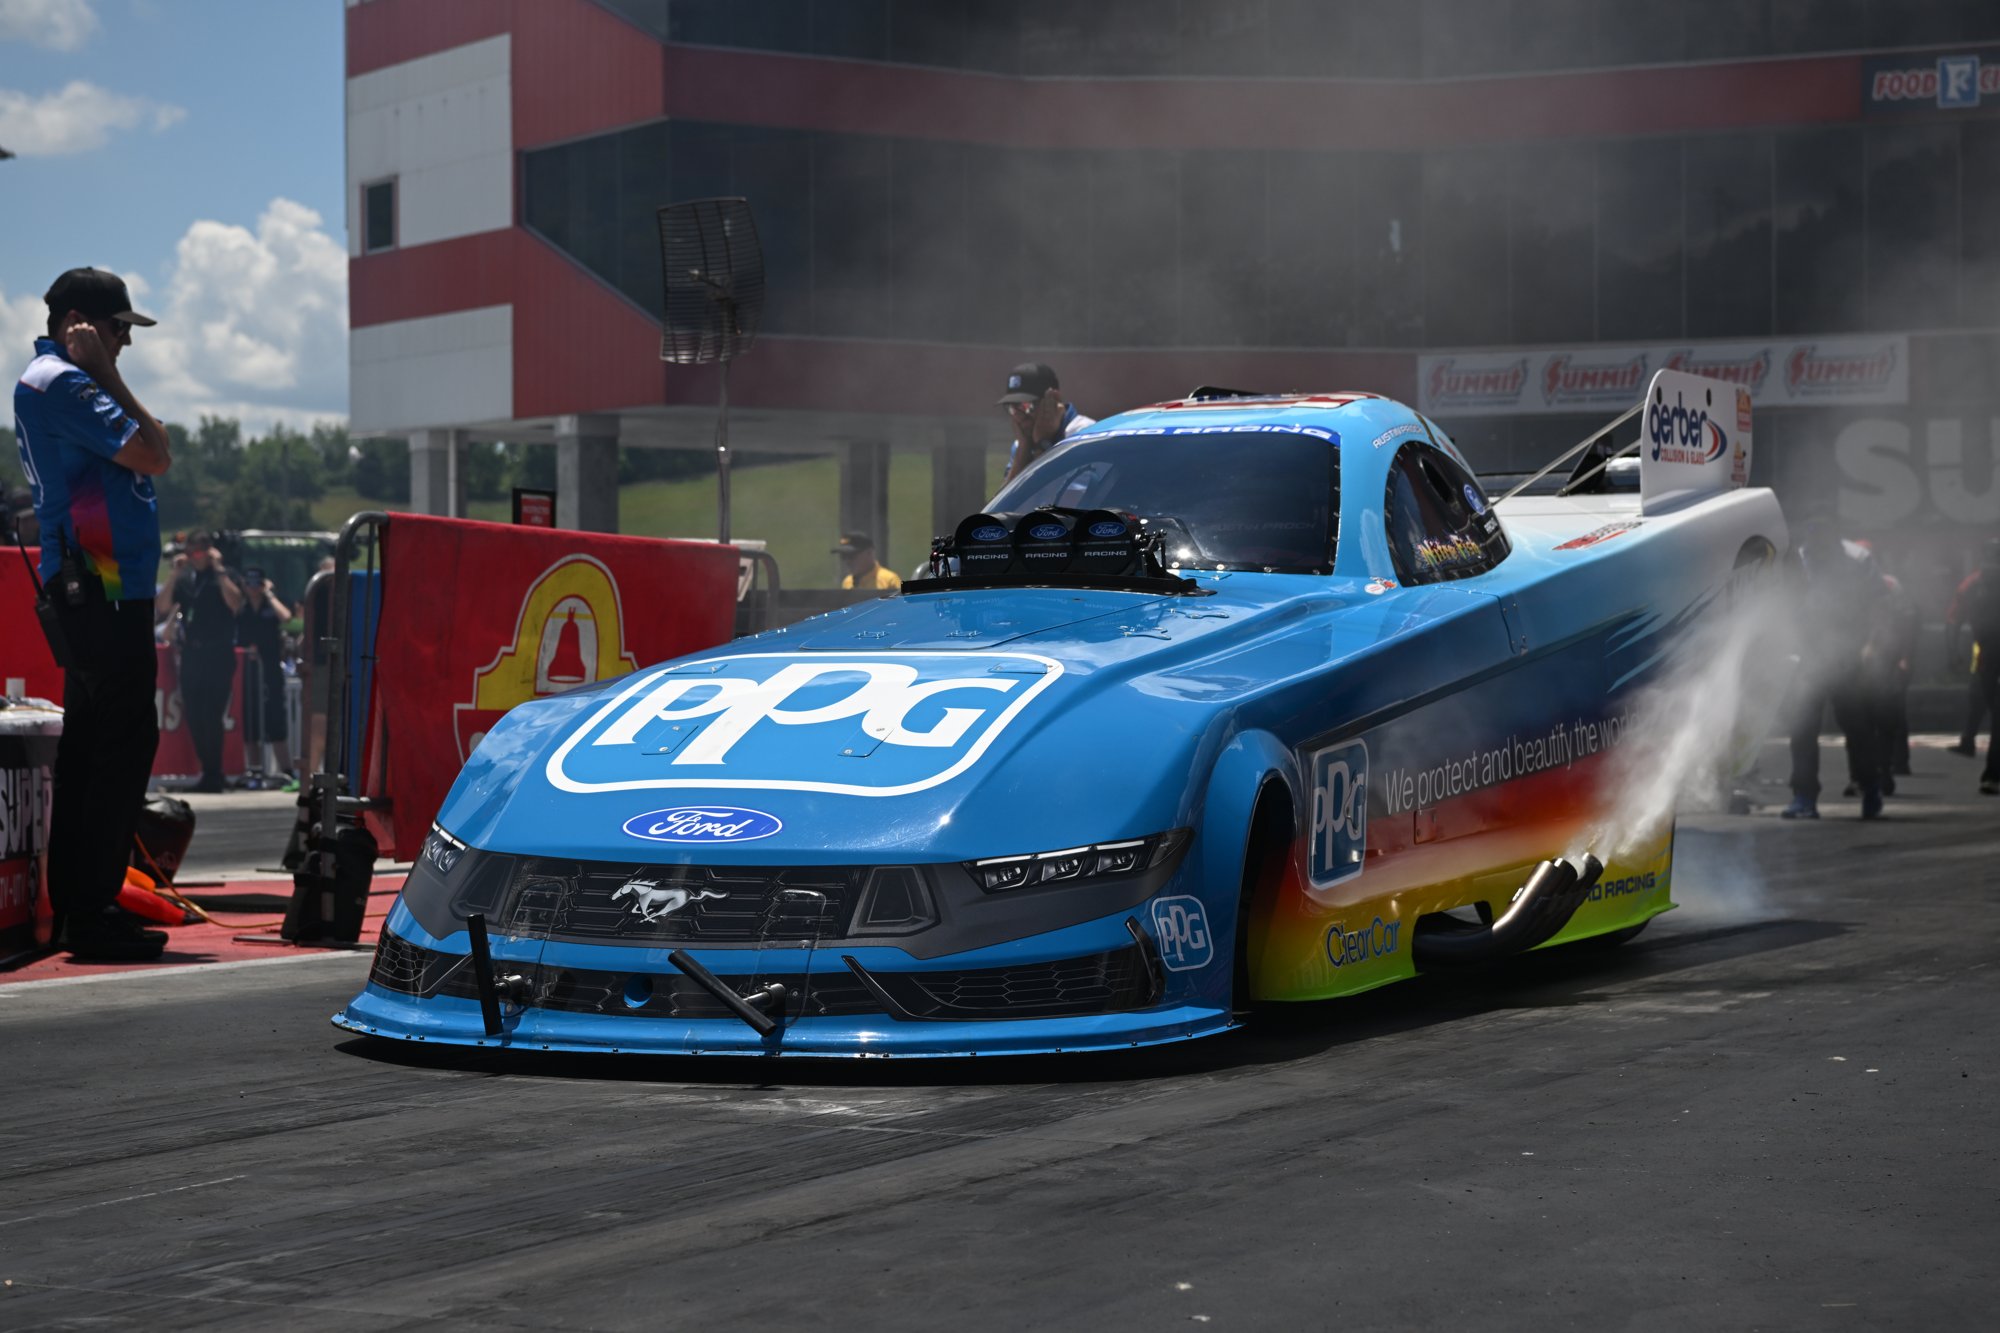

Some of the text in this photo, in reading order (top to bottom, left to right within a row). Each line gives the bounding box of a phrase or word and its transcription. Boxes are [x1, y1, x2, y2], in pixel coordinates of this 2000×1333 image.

[1873, 69, 1937, 101] FOOD
[1545, 358, 1641, 394] SUMMIT
[1173, 424, 1333, 440] RACING
[1650, 391, 1708, 462] gerber
[977, 528, 1002, 539] Ford
[1036, 526, 1061, 538] Ford
[1095, 524, 1120, 535] Ford
[1025, 551, 1068, 559] RACING
[592, 663, 1020, 766] PPG
[1385, 768, 1414, 815] We
[1418, 750, 1479, 815] protect
[1481, 736, 1511, 785] and
[1513, 722, 1573, 772] beautify
[1574, 716, 1599, 757] the
[648, 810, 754, 838] Ford
[1312, 760, 1365, 871] PPG
[1604, 871, 1656, 899] RACING
[1157, 904, 1206, 962] PPG
[1326, 915, 1401, 969] ClearCar
